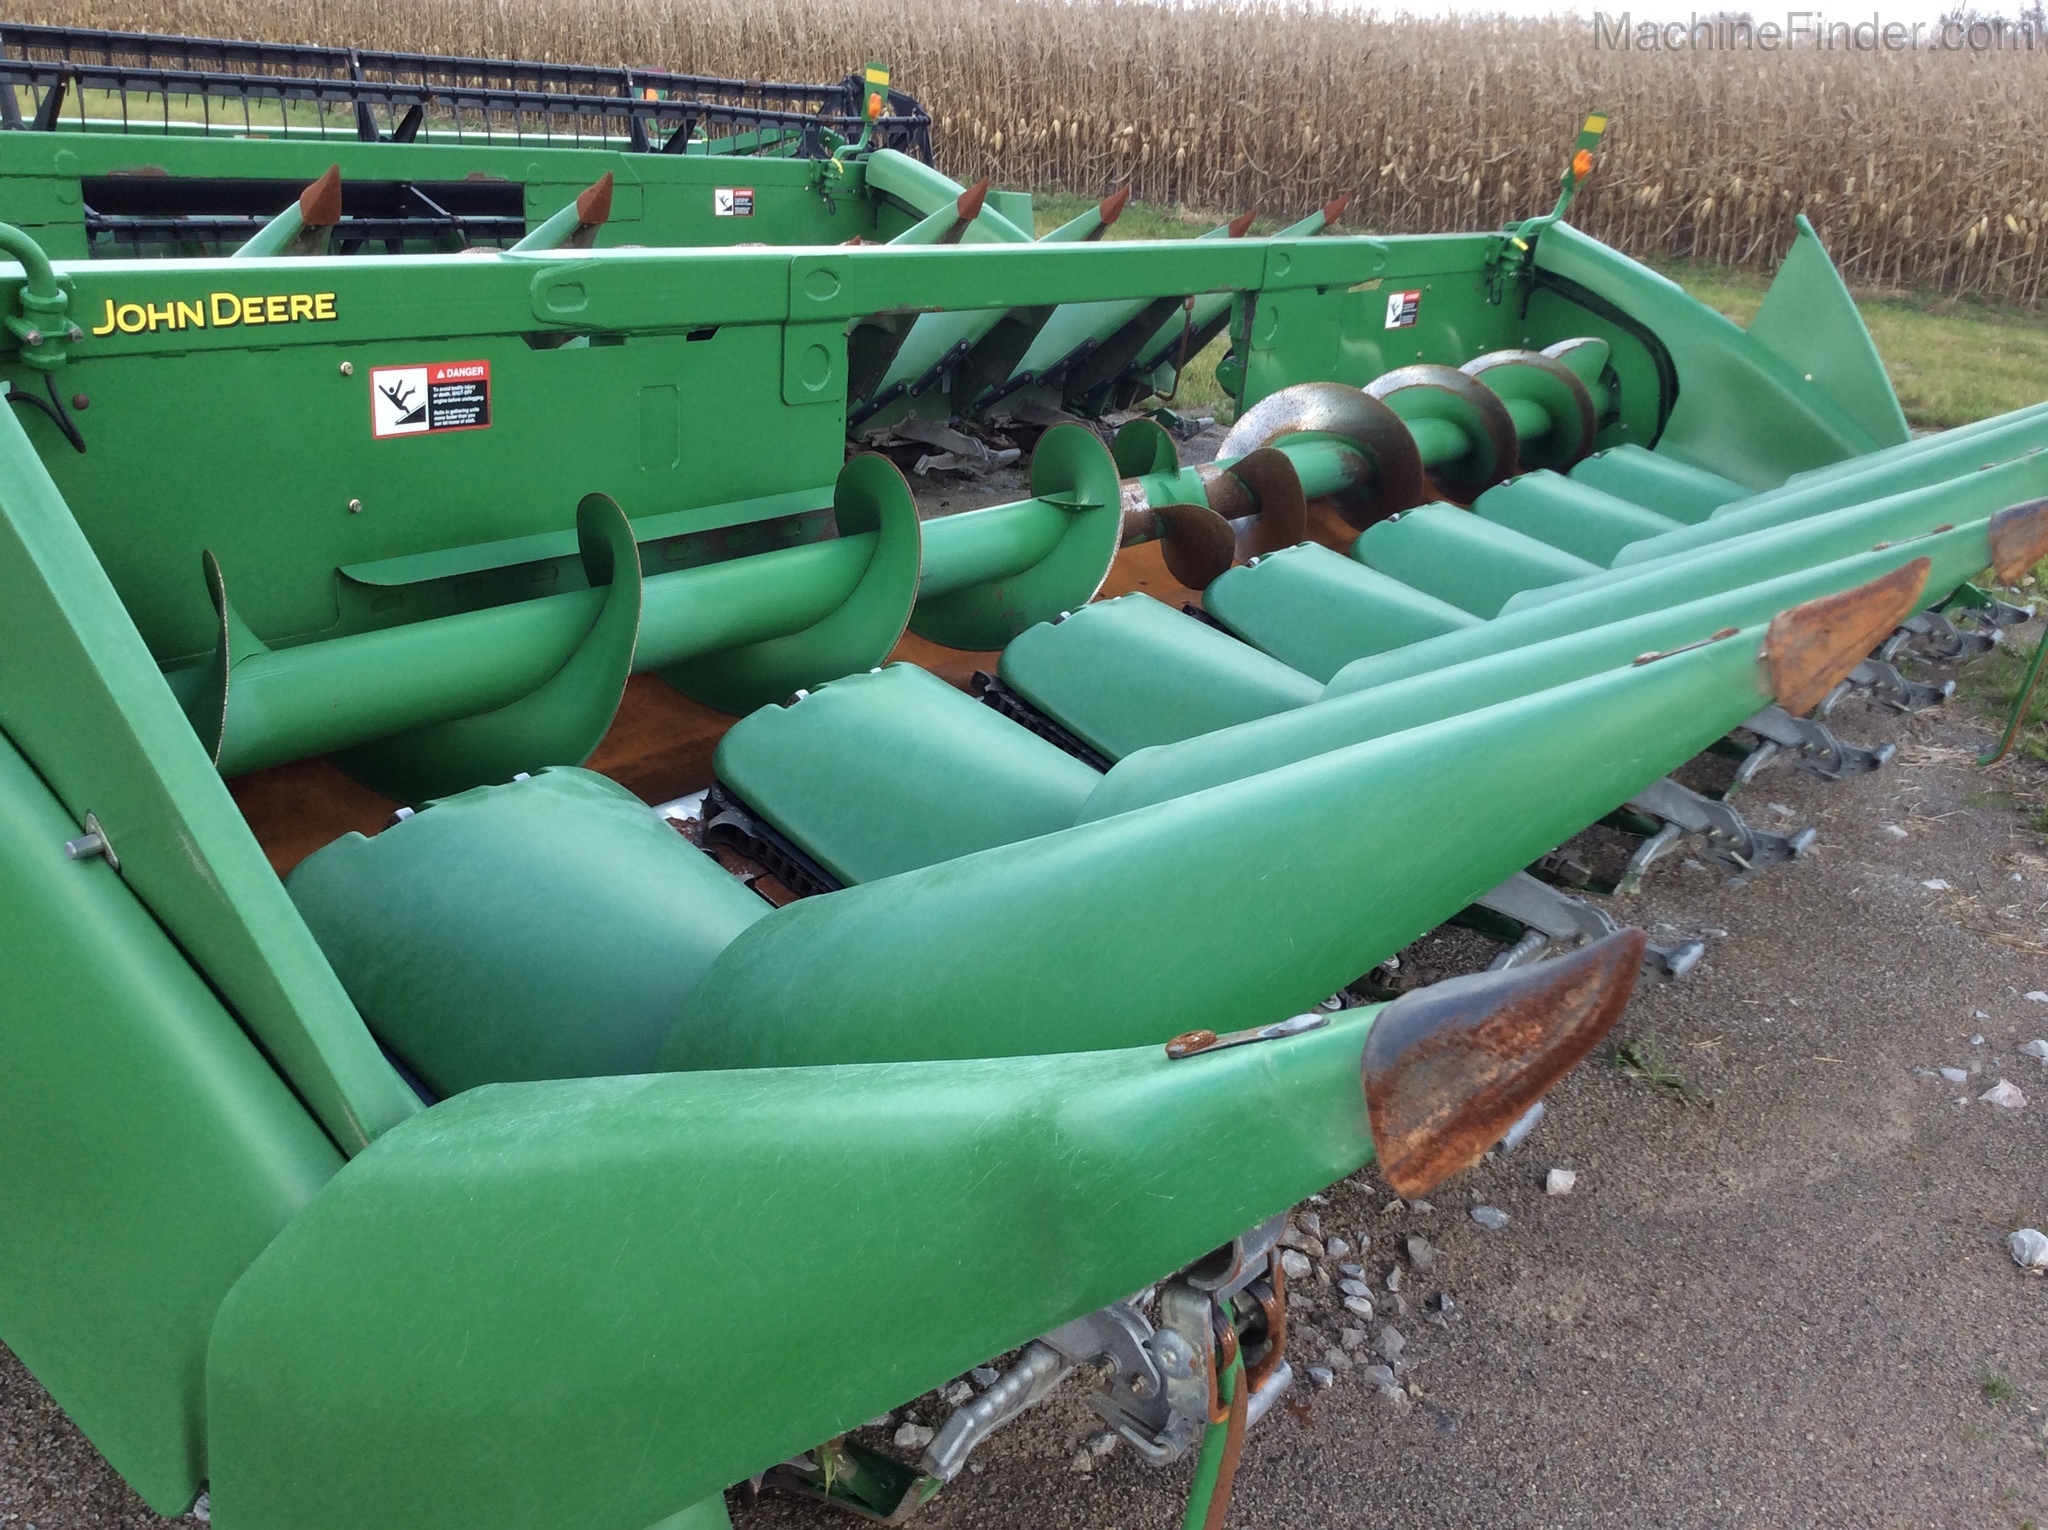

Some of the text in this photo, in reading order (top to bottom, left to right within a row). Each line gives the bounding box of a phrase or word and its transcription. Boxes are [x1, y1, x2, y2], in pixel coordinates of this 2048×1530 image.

[92, 292, 337, 335] JOHN DEERE
[446, 366, 484, 378] DANGER
